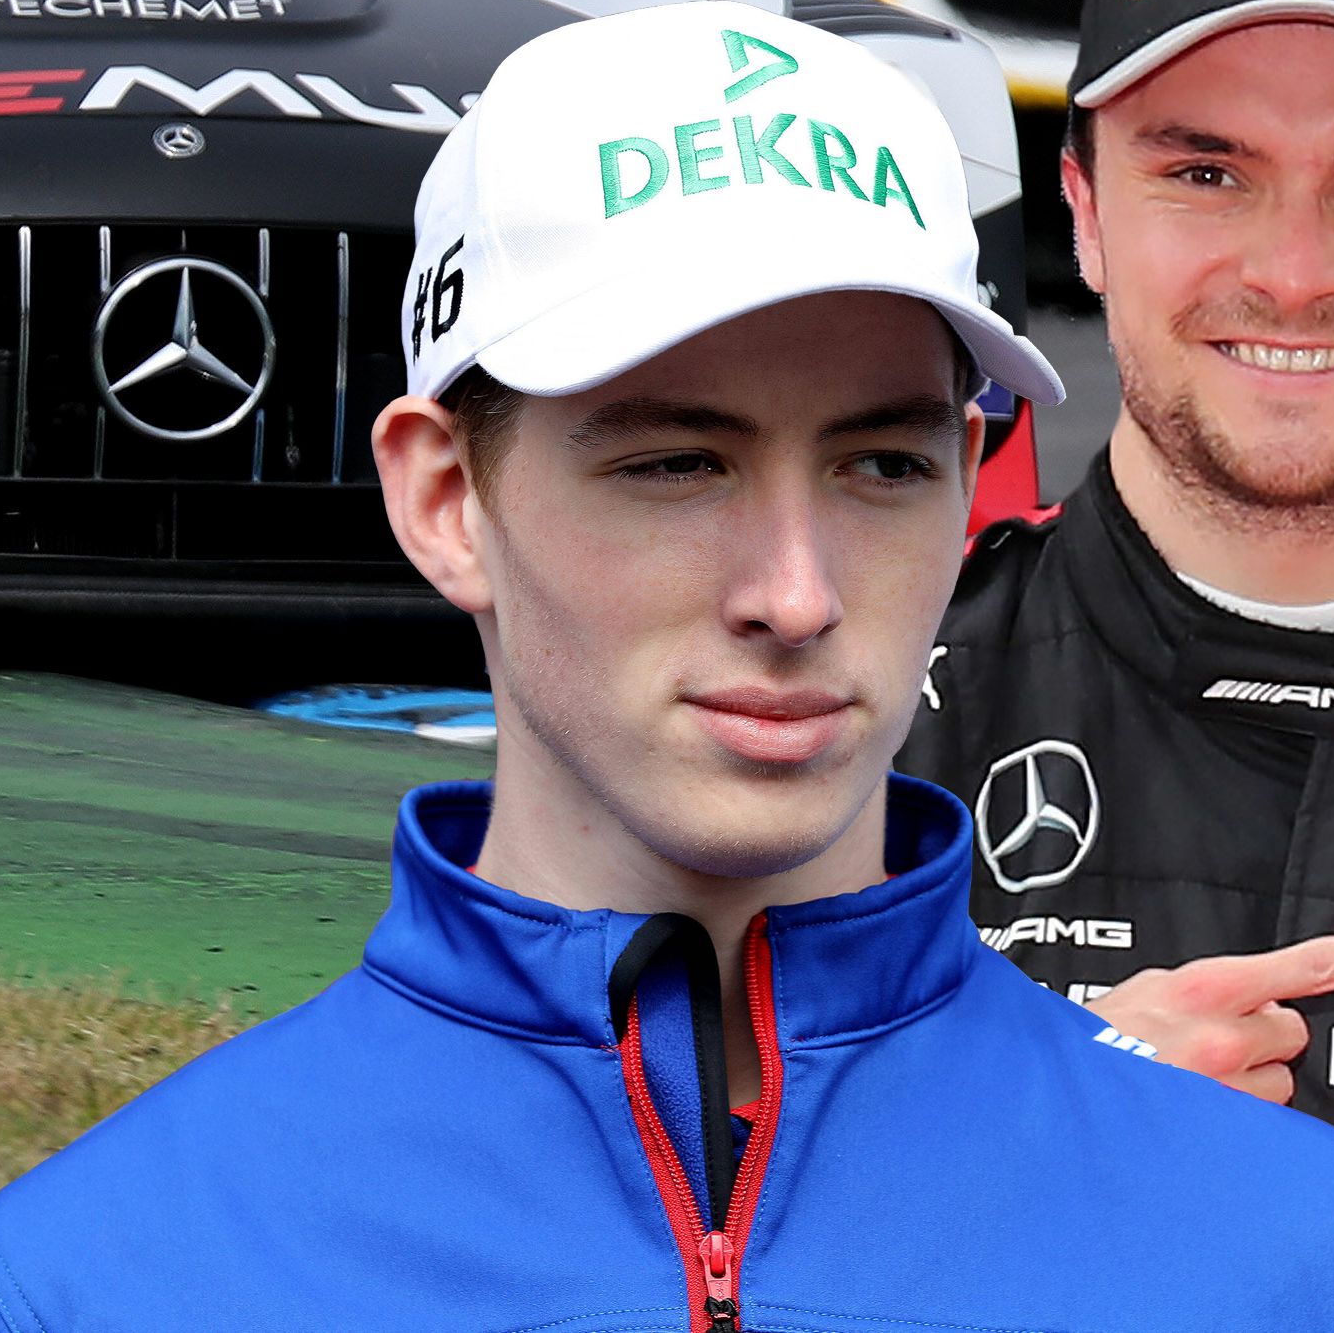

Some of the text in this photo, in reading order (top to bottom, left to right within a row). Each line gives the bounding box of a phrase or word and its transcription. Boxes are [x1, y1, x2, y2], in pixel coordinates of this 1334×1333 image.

[597, 111, 927, 231] DEKRA
[412, 232, 465, 366] #6
[998, 916, 1133, 951] AMG
